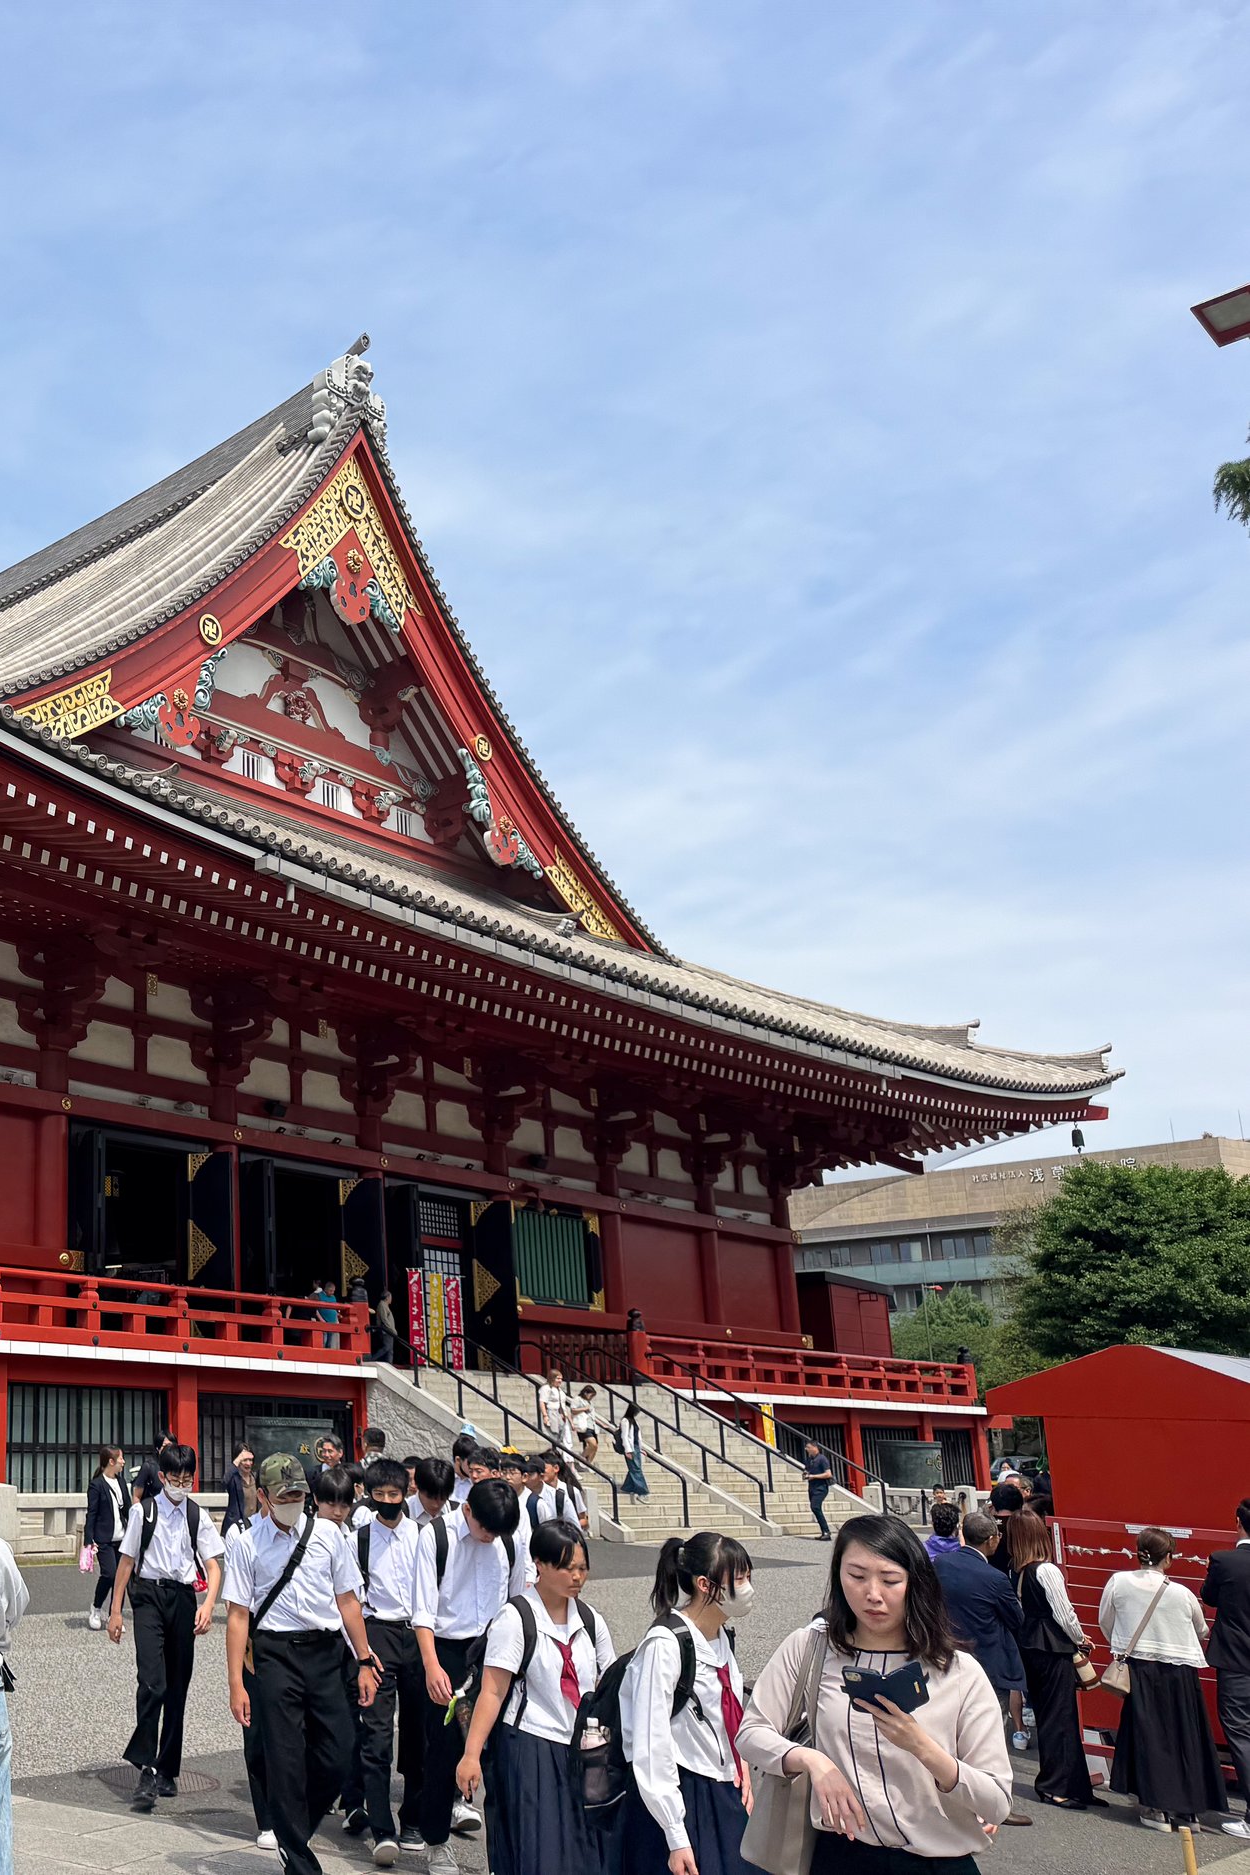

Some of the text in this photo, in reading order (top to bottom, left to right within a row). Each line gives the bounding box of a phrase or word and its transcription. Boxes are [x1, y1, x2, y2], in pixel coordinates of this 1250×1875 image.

[972, 1157, 1137, 1183] 社会福祉法人 浅草院
